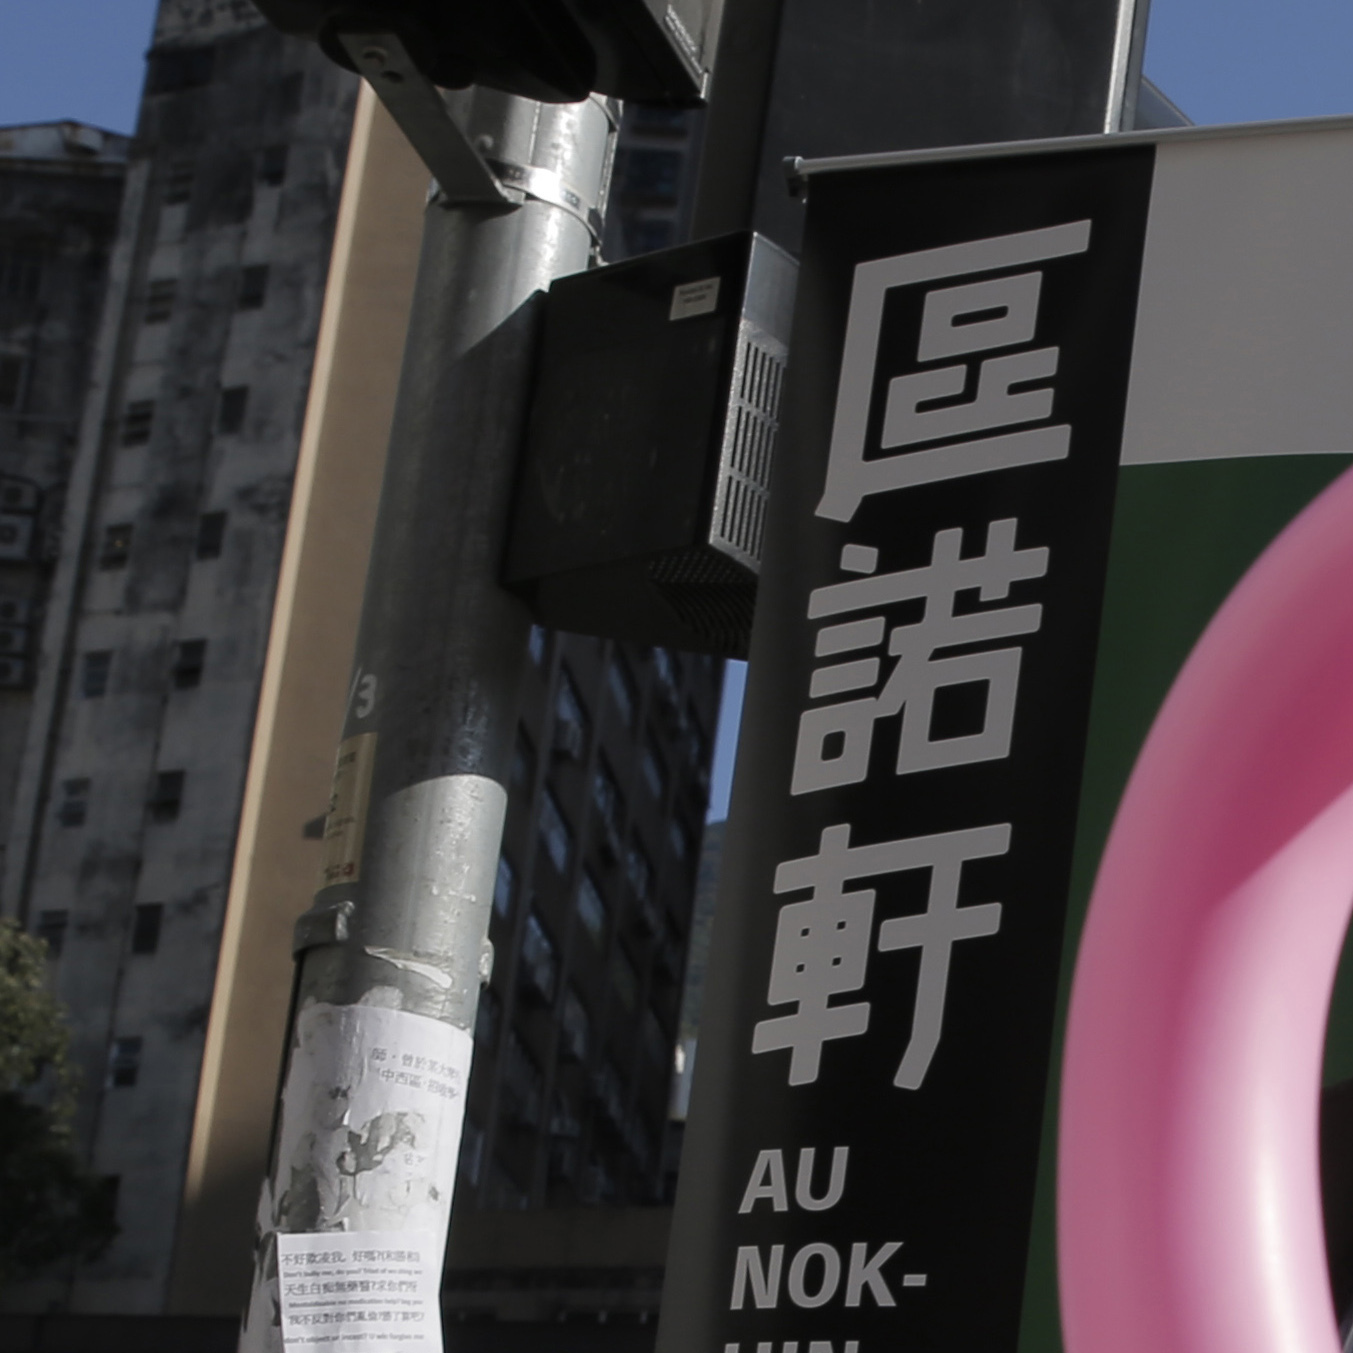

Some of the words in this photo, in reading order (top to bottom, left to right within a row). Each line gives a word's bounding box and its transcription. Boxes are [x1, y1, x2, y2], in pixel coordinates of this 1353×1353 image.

[751, 218, 1092, 1092] 區諾軒
[738, 1146, 849, 1214] AU
[730, 1242, 927, 1310] NOK-
